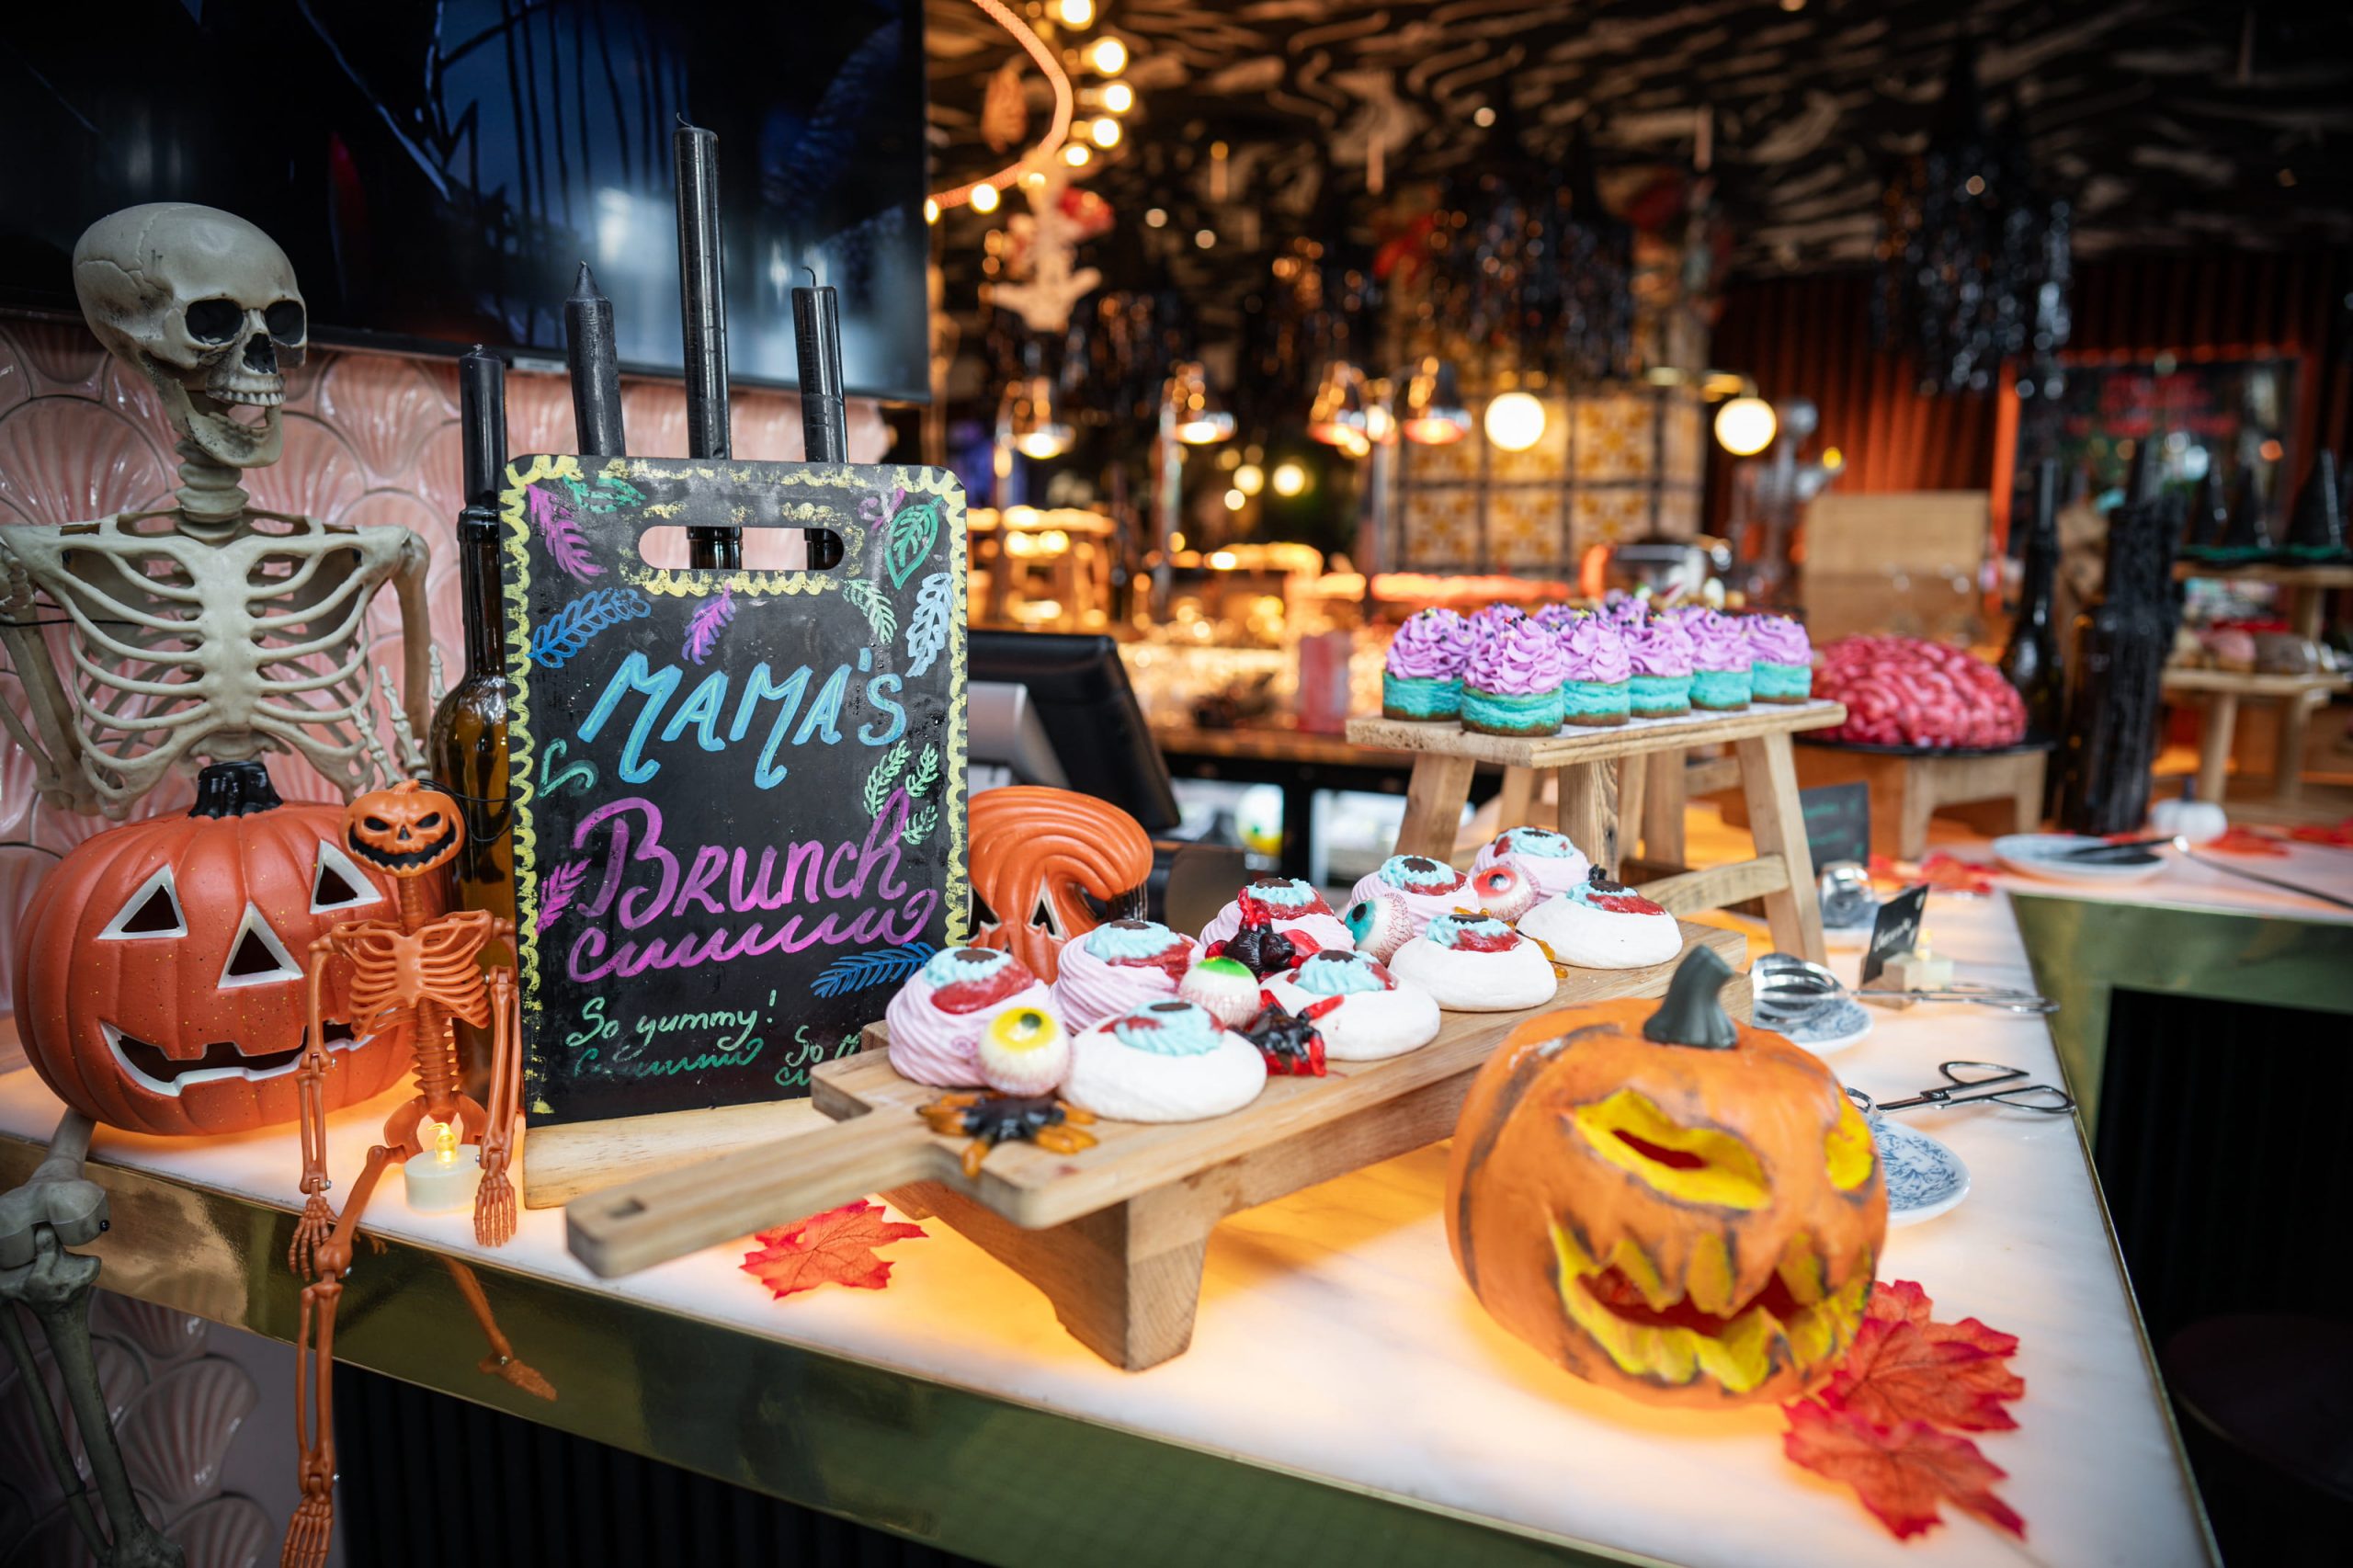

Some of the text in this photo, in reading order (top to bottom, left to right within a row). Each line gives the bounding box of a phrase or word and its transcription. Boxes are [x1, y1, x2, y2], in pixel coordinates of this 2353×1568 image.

[566, 996, 619, 1047] So
[614, 990, 777, 1062] yummy!
[786, 1025, 824, 1066] So
